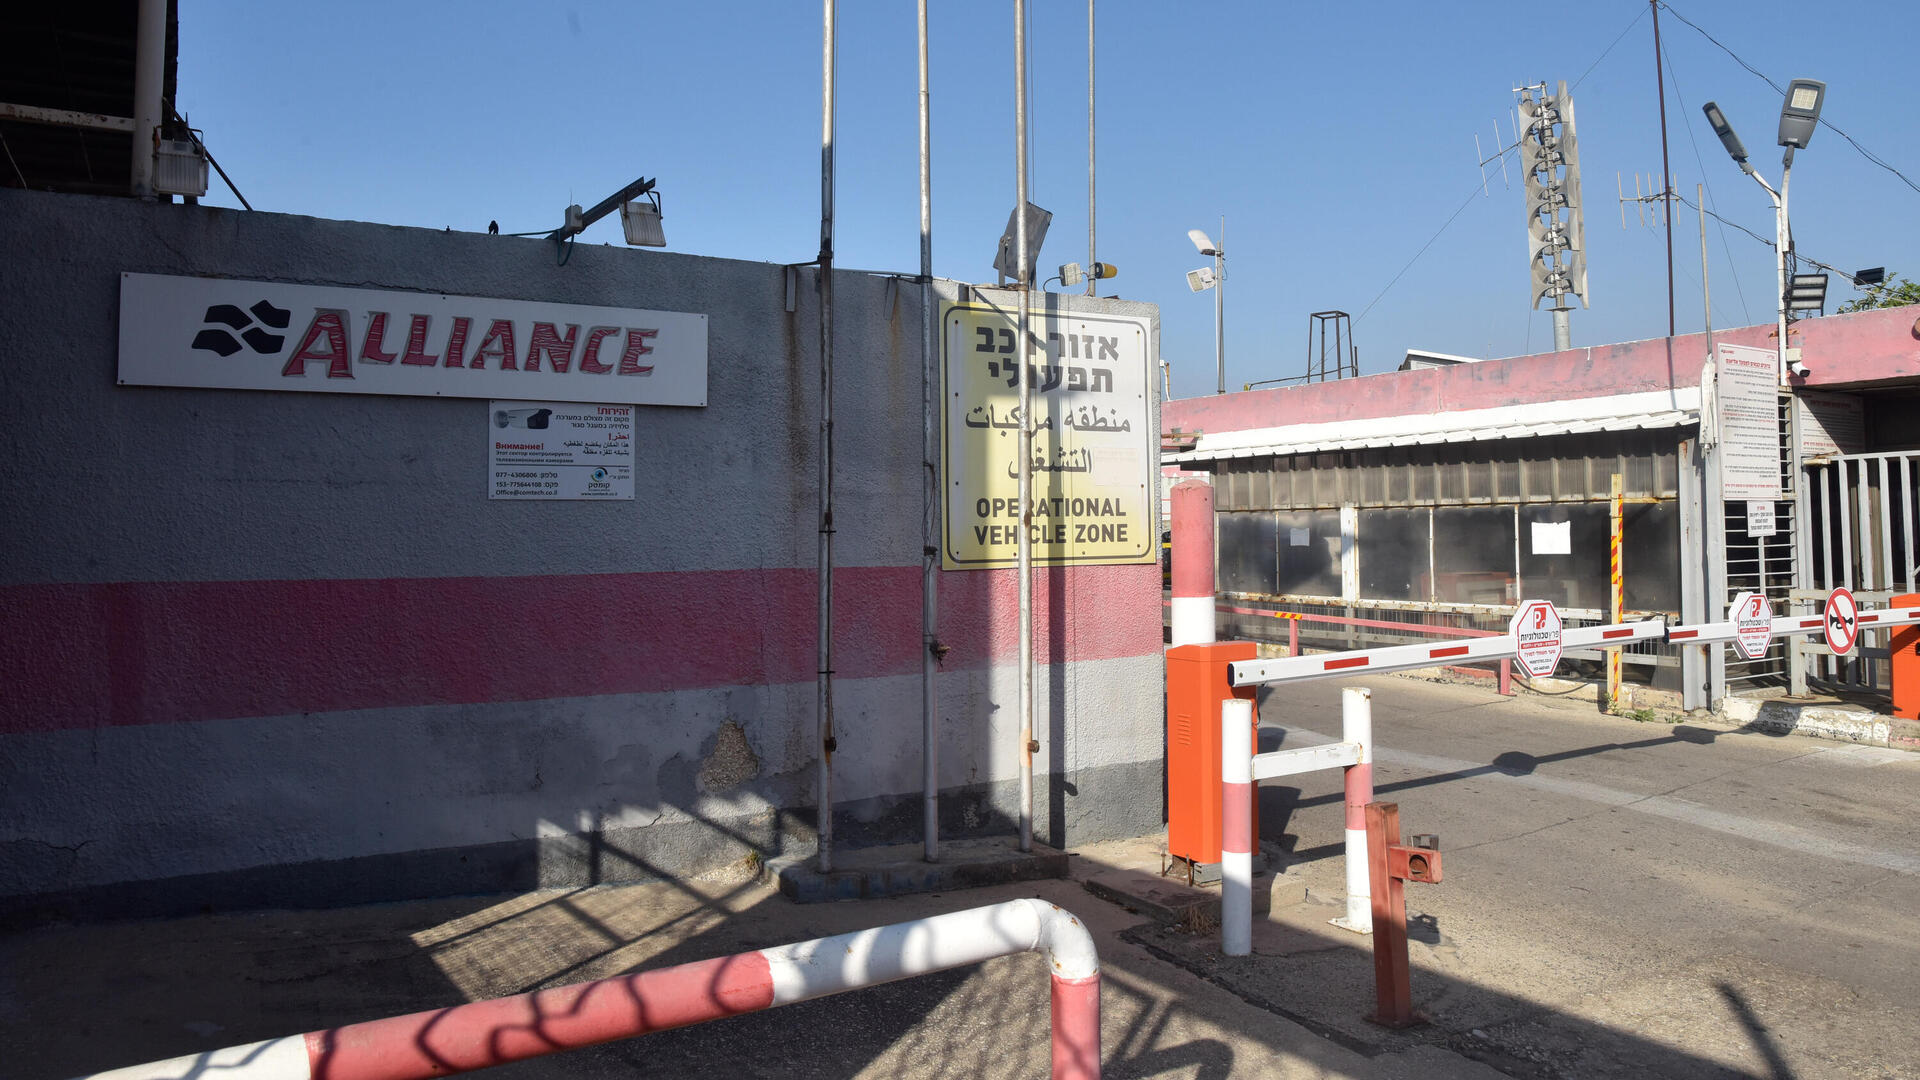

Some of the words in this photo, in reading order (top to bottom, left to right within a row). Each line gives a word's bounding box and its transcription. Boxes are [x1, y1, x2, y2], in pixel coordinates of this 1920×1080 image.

[281, 307, 660, 380] ALLIANCE
[1049, 332, 1119, 361] אזור
[988, 357, 1113, 393] תפעולי
[597, 406, 630, 416] זהירות!
[496, 442, 544, 450] Внимание!
[1008, 446, 1092, 480] التشغ
[976, 497, 1127, 518] OPEATIONAL
[974, 524, 1066, 545] VEHCLE
[1075, 523, 1128, 543] ZONE
